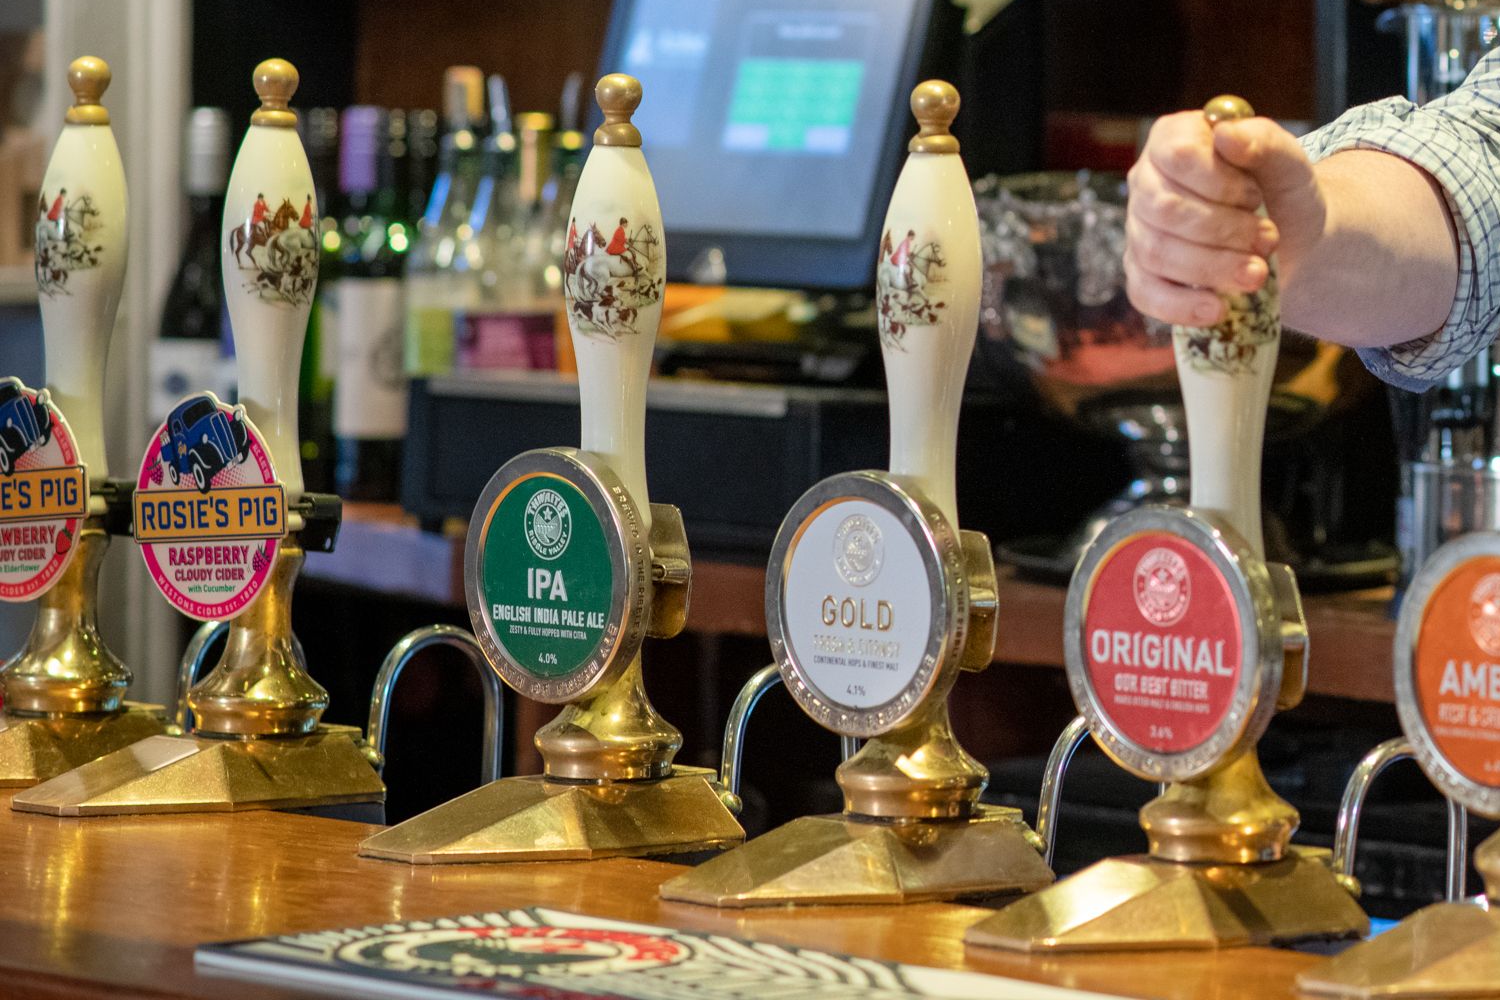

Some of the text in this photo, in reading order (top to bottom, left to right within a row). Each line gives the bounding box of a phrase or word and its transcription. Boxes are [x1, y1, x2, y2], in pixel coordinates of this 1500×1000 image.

[0, 478, 78, 511] E'S PIG
[527, 491, 569, 518] THWAITES
[141, 496, 278, 531] ROSIE'S PIG
[18, 549, 46, 560] CIDER
[168, 545, 250, 566] RASPBERRY
[548, 531, 568, 556] VALLEY
[4, 564, 40, 573] Elderflower
[175, 567, 245, 582] CLOUDY CIDER
[636, 559, 646, 584] THE
[158, 574, 195, 613] WESTONS
[197, 605, 223, 616] CIDER
[188, 582, 236, 593] with Cucumber
[527, 567, 568, 602] IPA
[492, 604, 605, 629] ENGLISH INDIA PALE ALE
[821, 594, 895, 632] GOLD
[509, 624, 523, 634] ZESTY
[528, 626, 541, 637] FULLY
[541, 628, 560, 638] HOPPED
[561, 630, 573, 639] WITH
[538, 652, 558, 665] 4.0%
[813, 654, 847, 667] CONTINENTAL
[867, 660, 885, 671] FINEST
[885, 662, 899, 672] MALT
[1091, 629, 1234, 677] ORIGINAL
[846, 684, 867, 697] 4.1%
[1140, 675, 1169, 696] BEST
[1170, 679, 1208, 700] BITTER
